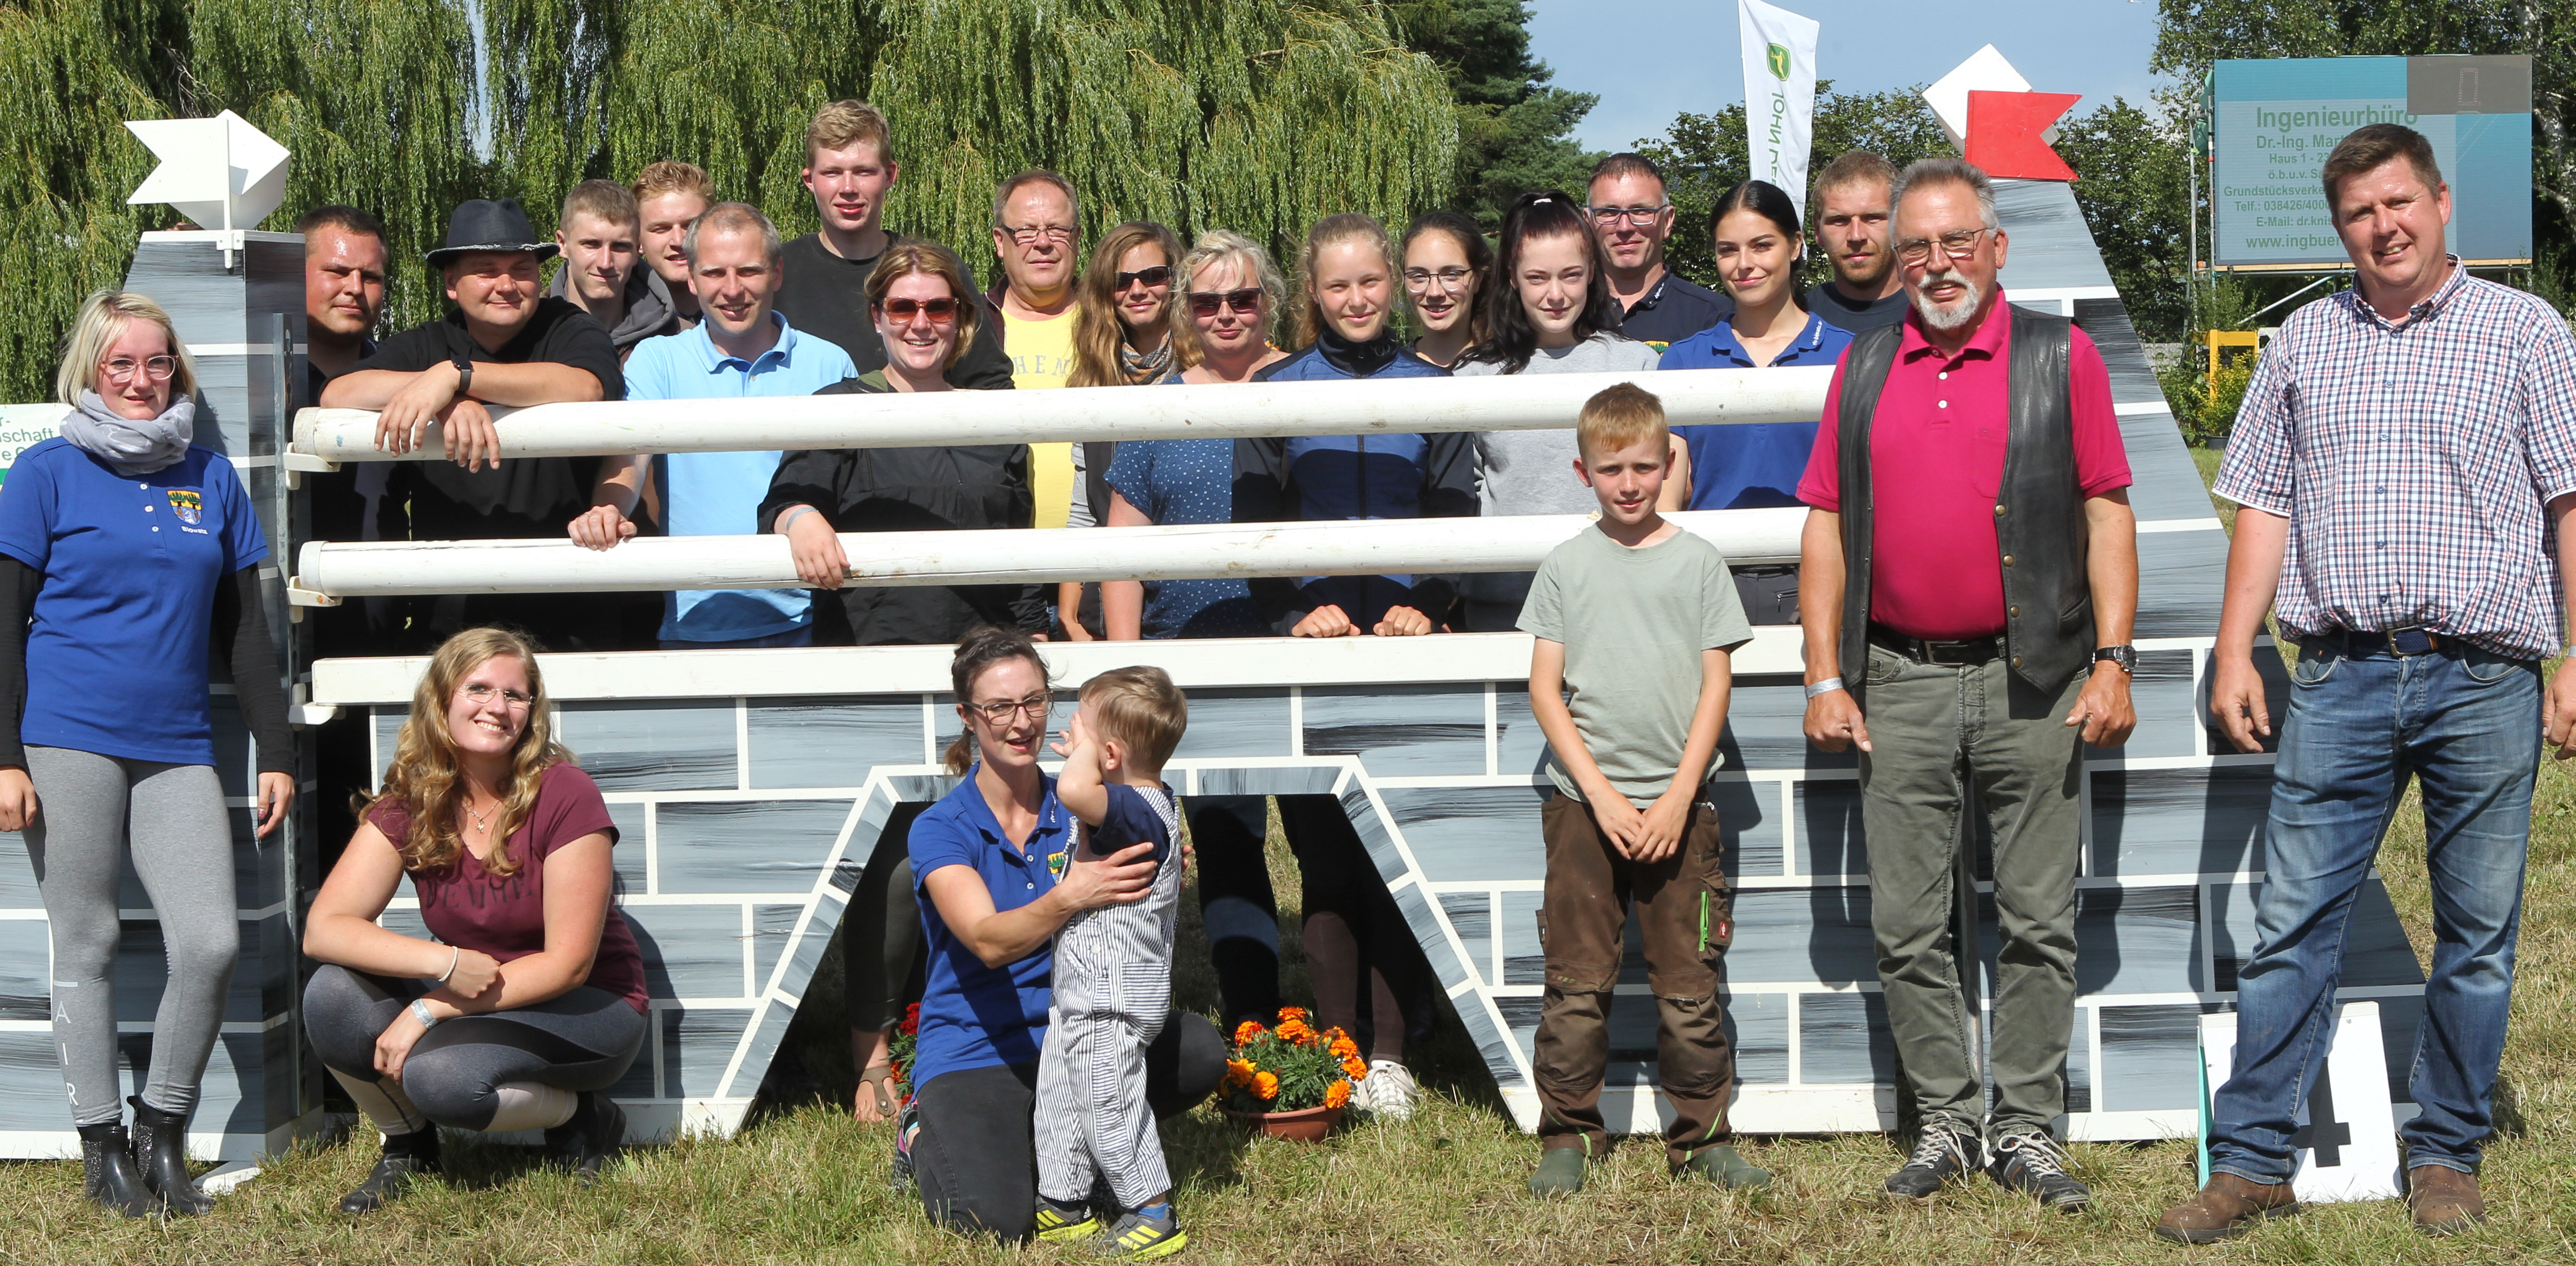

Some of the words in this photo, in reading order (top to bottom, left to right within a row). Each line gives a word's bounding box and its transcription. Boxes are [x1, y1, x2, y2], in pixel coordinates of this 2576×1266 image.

[2256, 104, 2418, 133] Ingenieurbüro
[2256, 135, 2308, 151] Dr.-Ing.
[2269, 153, 2297, 163] Haus
[2301, 153, 2306, 163] 1
[2268, 169, 2307, 179] ö.b.u.v.
[2234, 200, 2261, 212] Telf.:
[2256, 216, 2293, 227] E-Mail:
